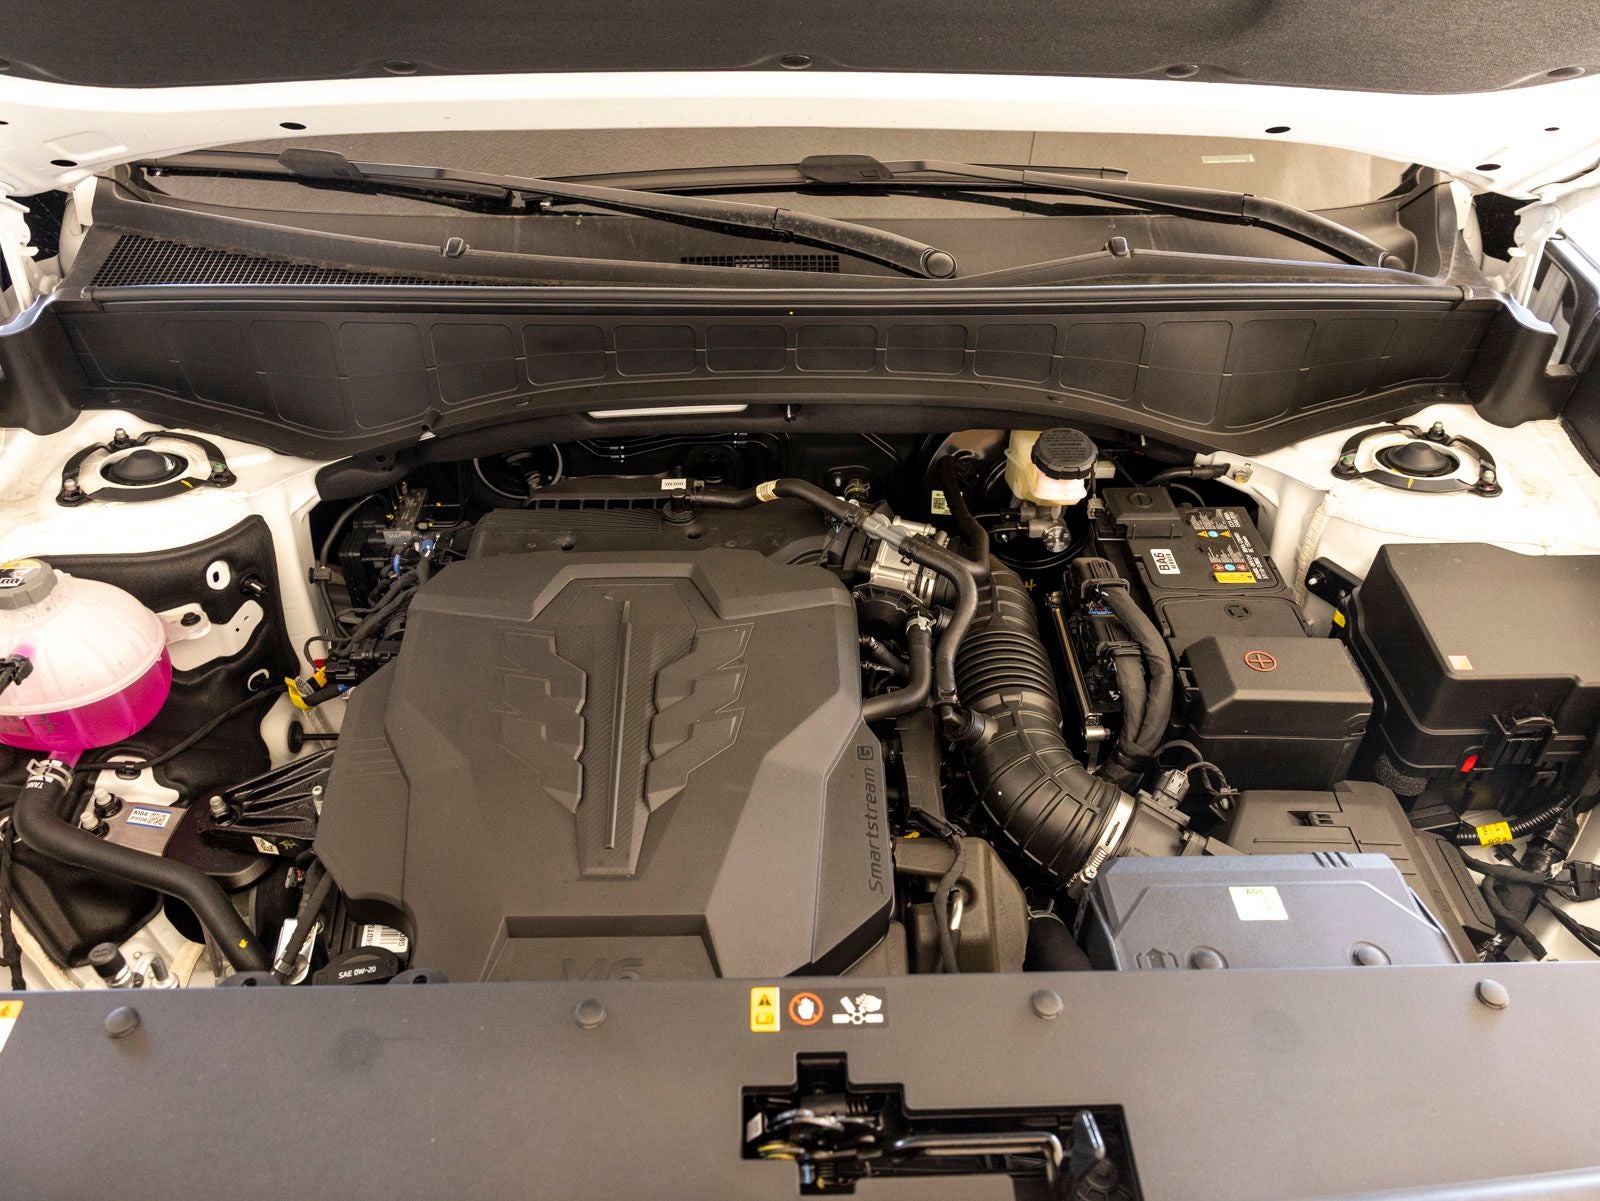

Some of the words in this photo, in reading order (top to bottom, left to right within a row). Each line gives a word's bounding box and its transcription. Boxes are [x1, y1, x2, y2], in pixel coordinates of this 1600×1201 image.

[1153, 552, 1170, 571] BA6
[864, 767, 884, 894] Smartstream
[338, 969, 353, 980] SAE
[353, 965, 377, 976] 0W-20
